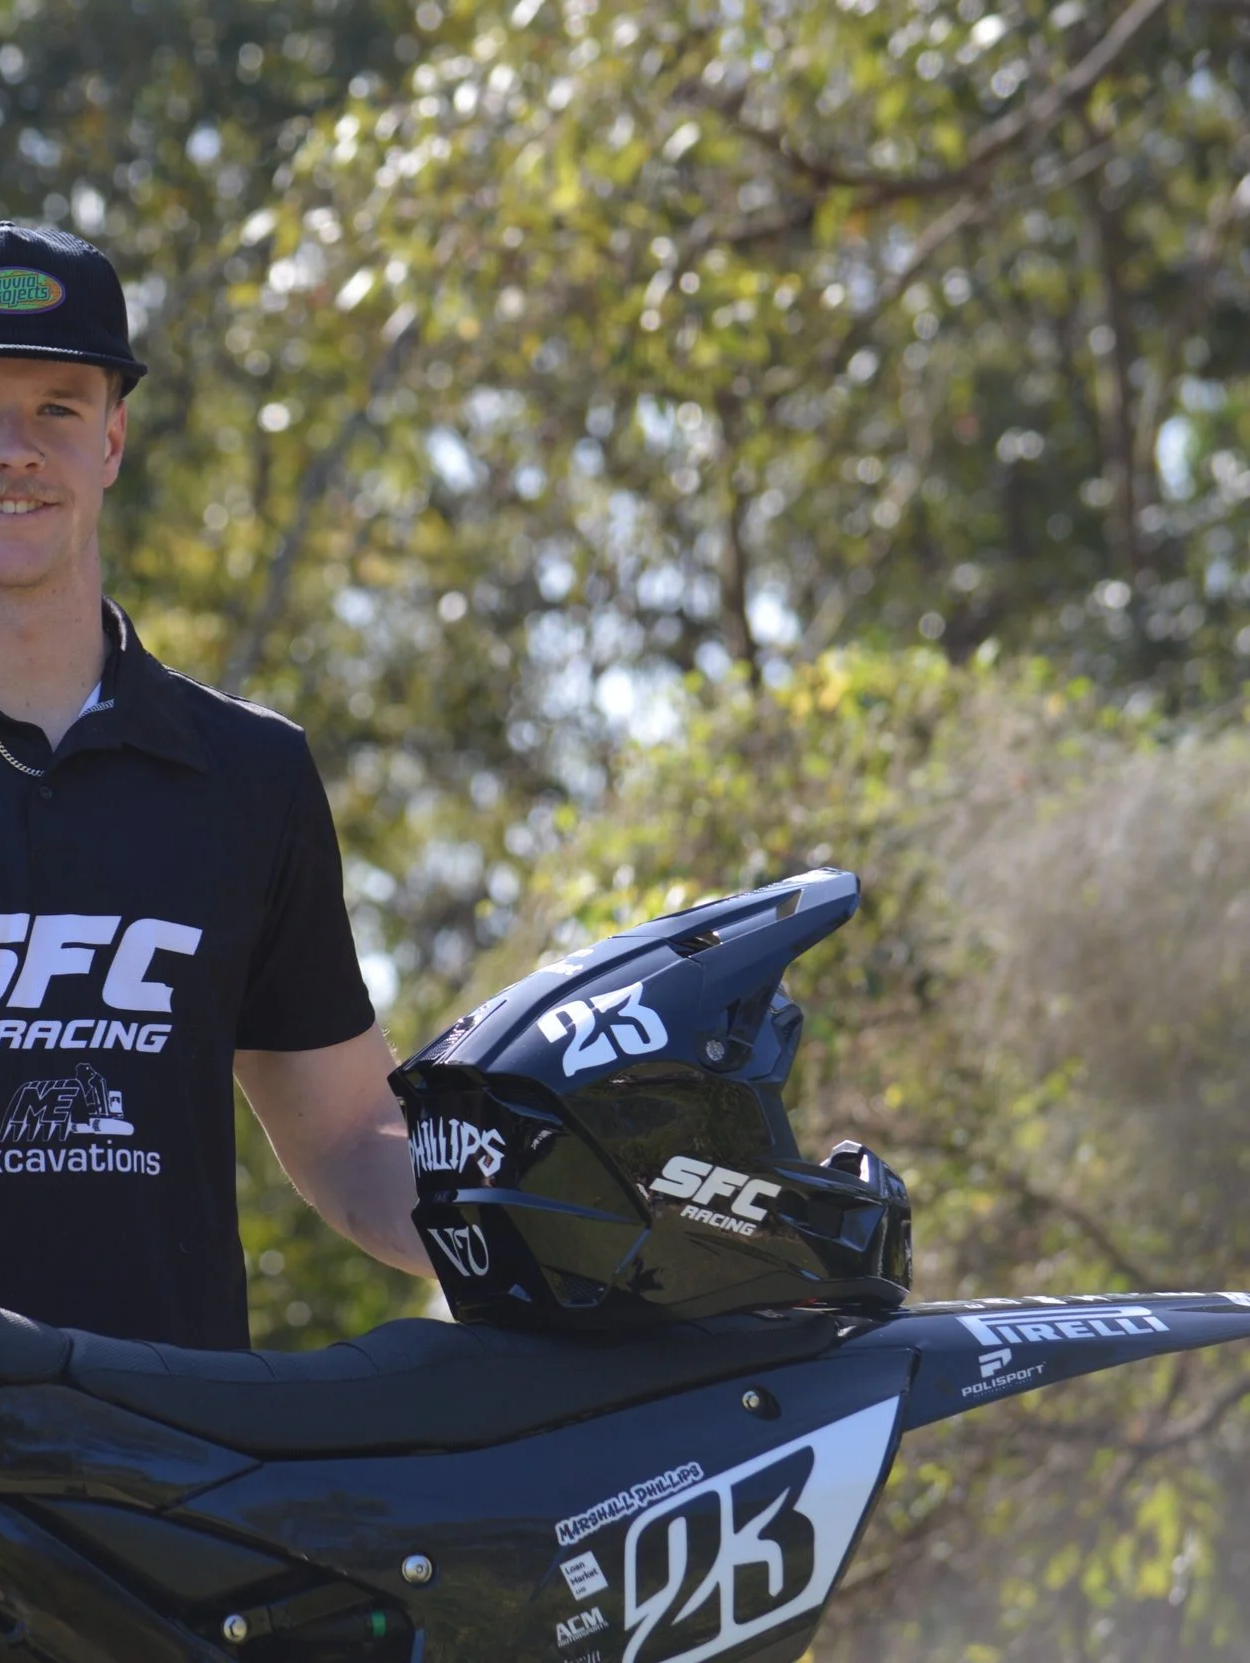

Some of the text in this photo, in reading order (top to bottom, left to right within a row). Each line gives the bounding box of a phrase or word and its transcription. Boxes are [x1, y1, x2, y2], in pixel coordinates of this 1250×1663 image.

[537, 981, 668, 1077] 23
[649, 1155, 783, 1222] SFC
[680, 1204, 758, 1237] RACING
[955, 1305, 1170, 1346] PIRELLI
[961, 1364, 1045, 1397] POLISPORT
[556, 1463, 703, 1545] MARSHALL PHILLIPS
[565, 1561, 585, 1575] Loan
[570, 1568, 599, 1586] Market
[556, 1606, 605, 1645] ACM
